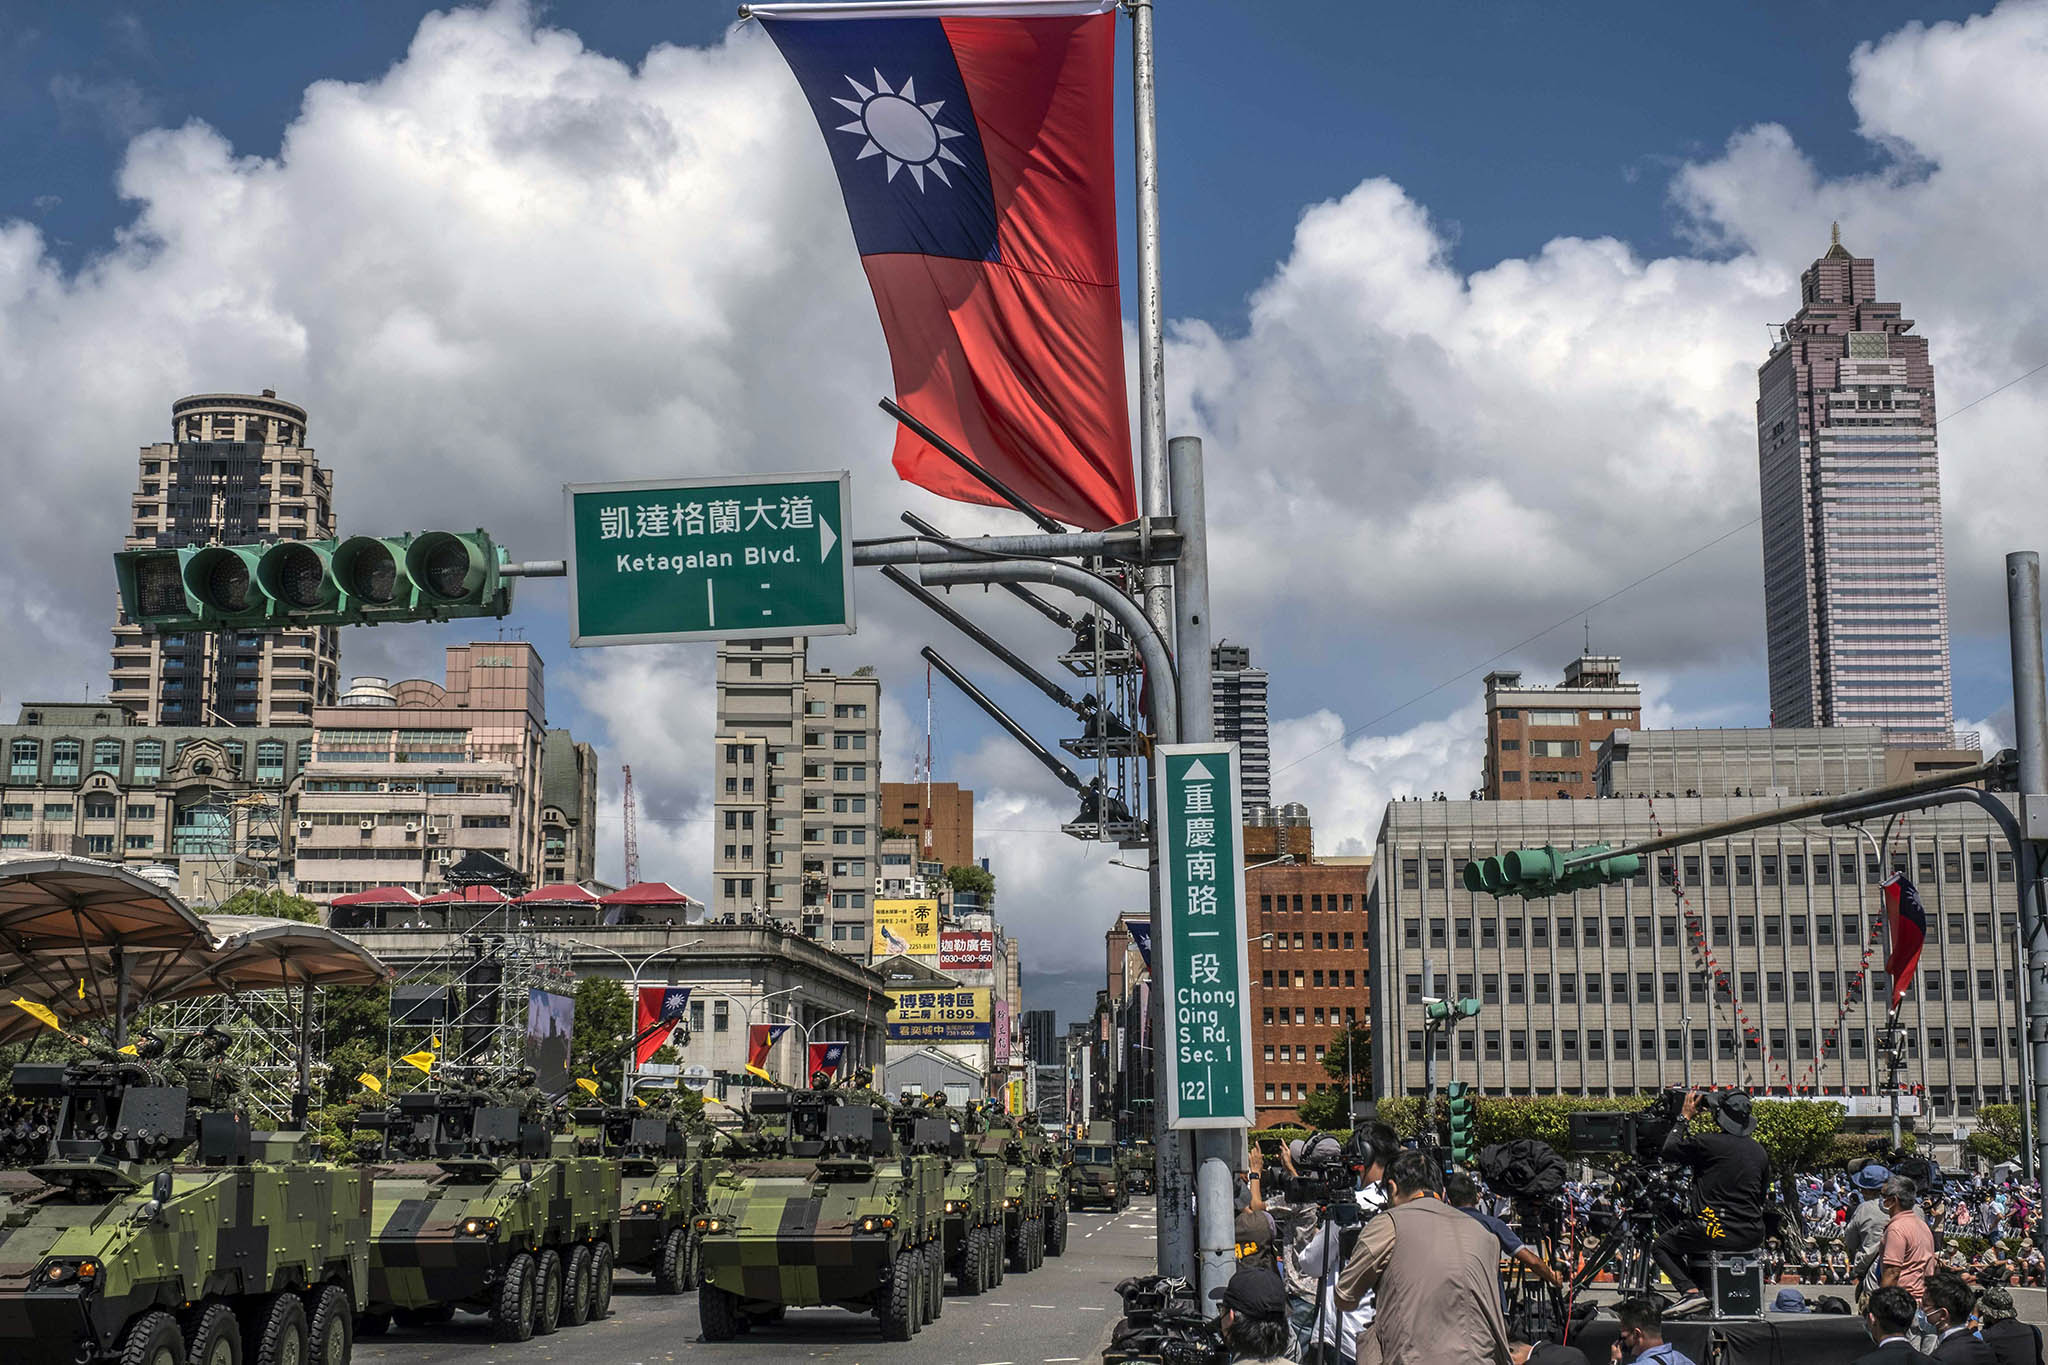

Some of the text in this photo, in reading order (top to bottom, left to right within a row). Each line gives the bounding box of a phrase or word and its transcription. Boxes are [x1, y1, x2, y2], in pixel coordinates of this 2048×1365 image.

[599, 495, 814, 540] 凱達格蘭大道
[616, 544, 801, 575] Ketagalan Blvd.
[1183, 783, 1221, 985] 重慶南路一段
[941, 939, 992, 952] 迦勒廣告
[941, 954, 992, 963] 0930-030-950
[899, 992, 975, 1009] 博愛特區
[1178, 988, 1236, 1009] Chong
[899, 1010, 931, 1020] 正二房
[938, 1009, 975, 1020] 1899
[1178, 1007, 1219, 1028] Qing
[1180, 1026, 1230, 1043] S. Rd.
[1180, 1045, 1232, 1063] Sec. 1
[1180, 1081, 1206, 1101] 122
